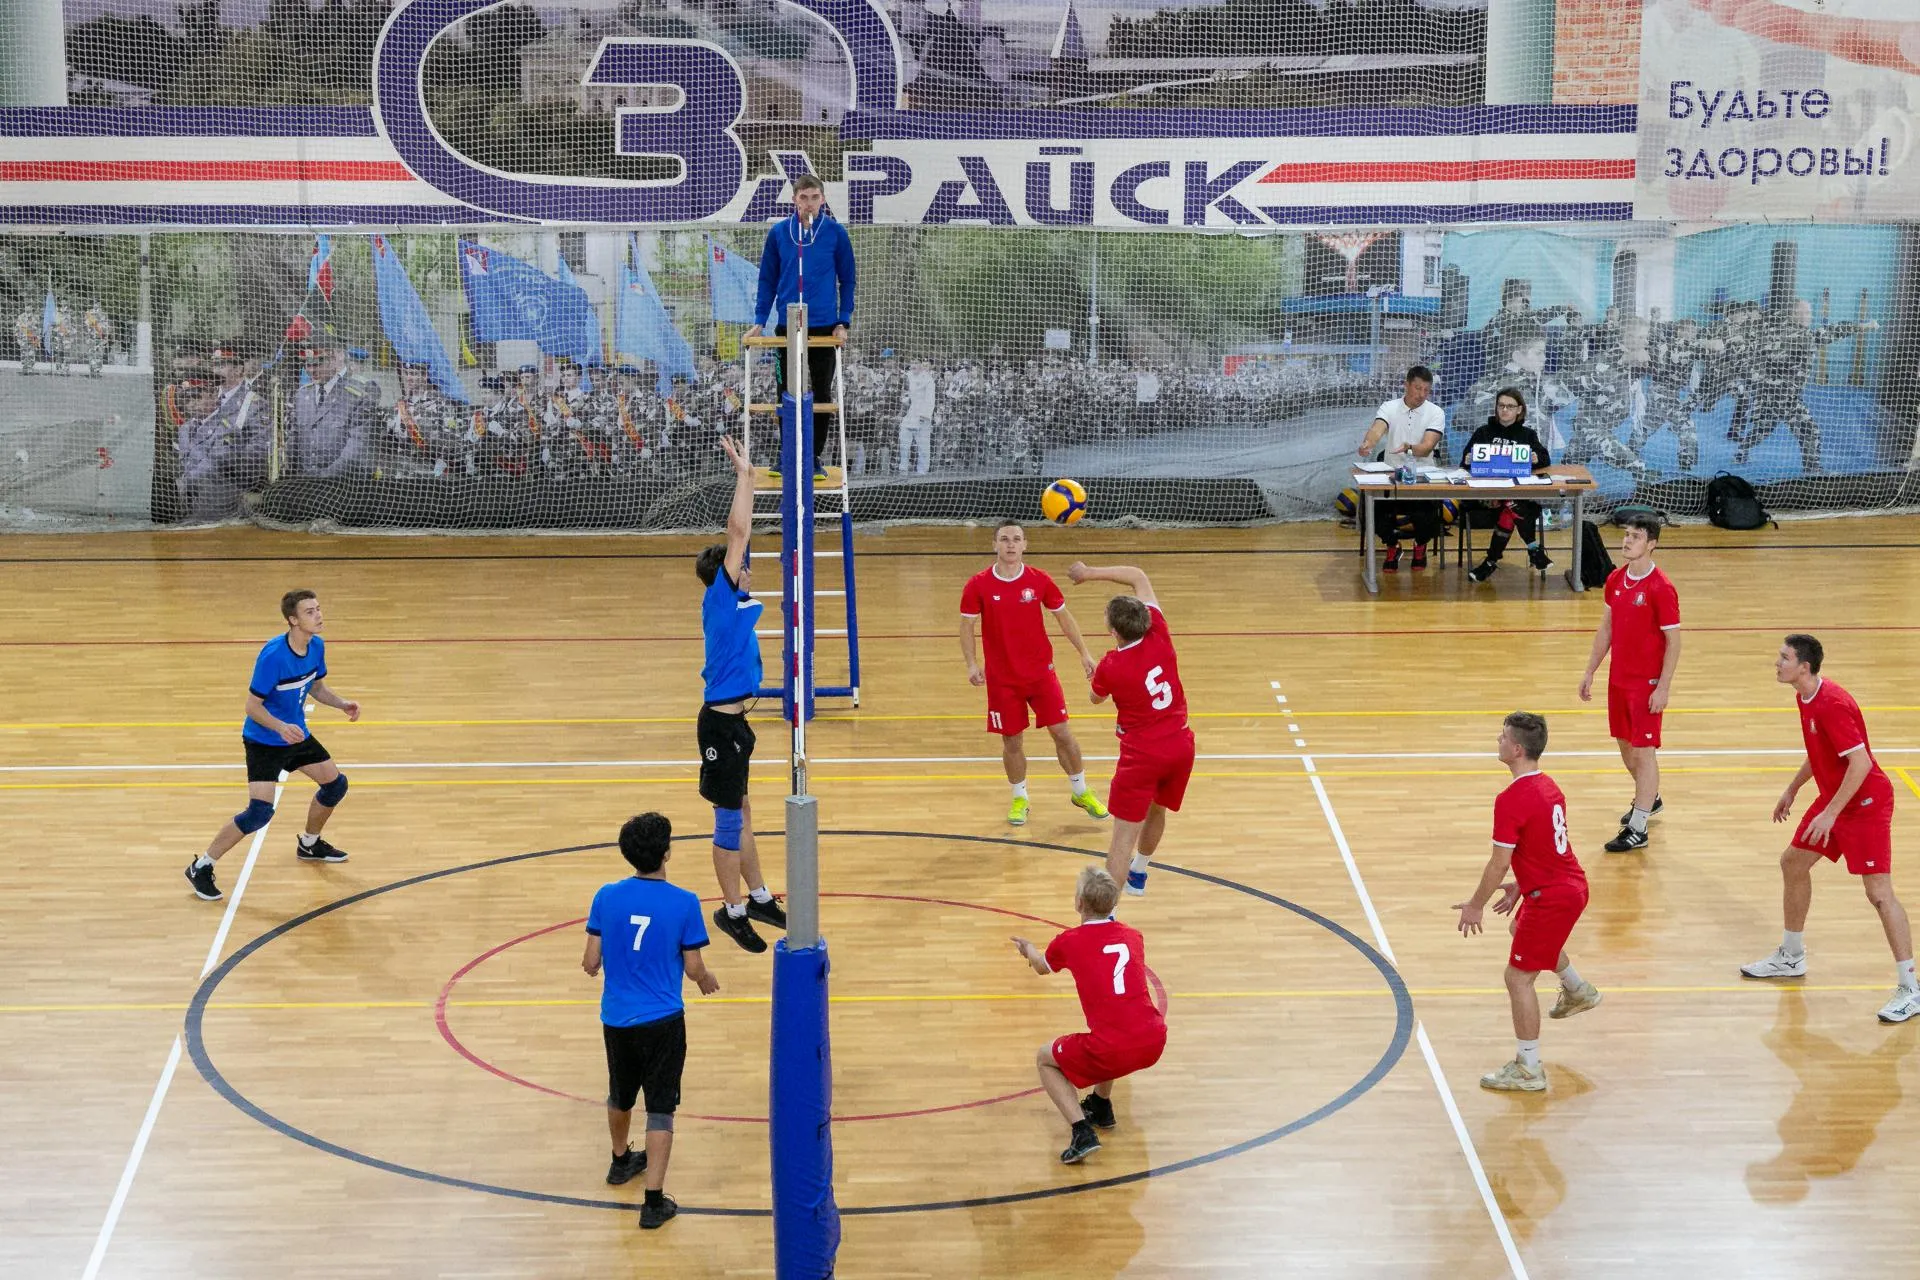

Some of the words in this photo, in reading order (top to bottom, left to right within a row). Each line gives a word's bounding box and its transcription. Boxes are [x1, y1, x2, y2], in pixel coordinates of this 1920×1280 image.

[1669, 80, 1832, 128] Будьте
[580, 36, 1270, 226] ЗАРАЙСК
[1664, 137, 1891, 185] здоровы!
[1476, 447, 1487, 460] 5
[1514, 447, 1529, 461] 10
[1145, 664, 1173, 710] 5
[989, 710, 1003, 730] 11
[1552, 804, 1568, 855] 8
[629, 914, 651, 951] 7
[1102, 943, 1130, 995] 7
